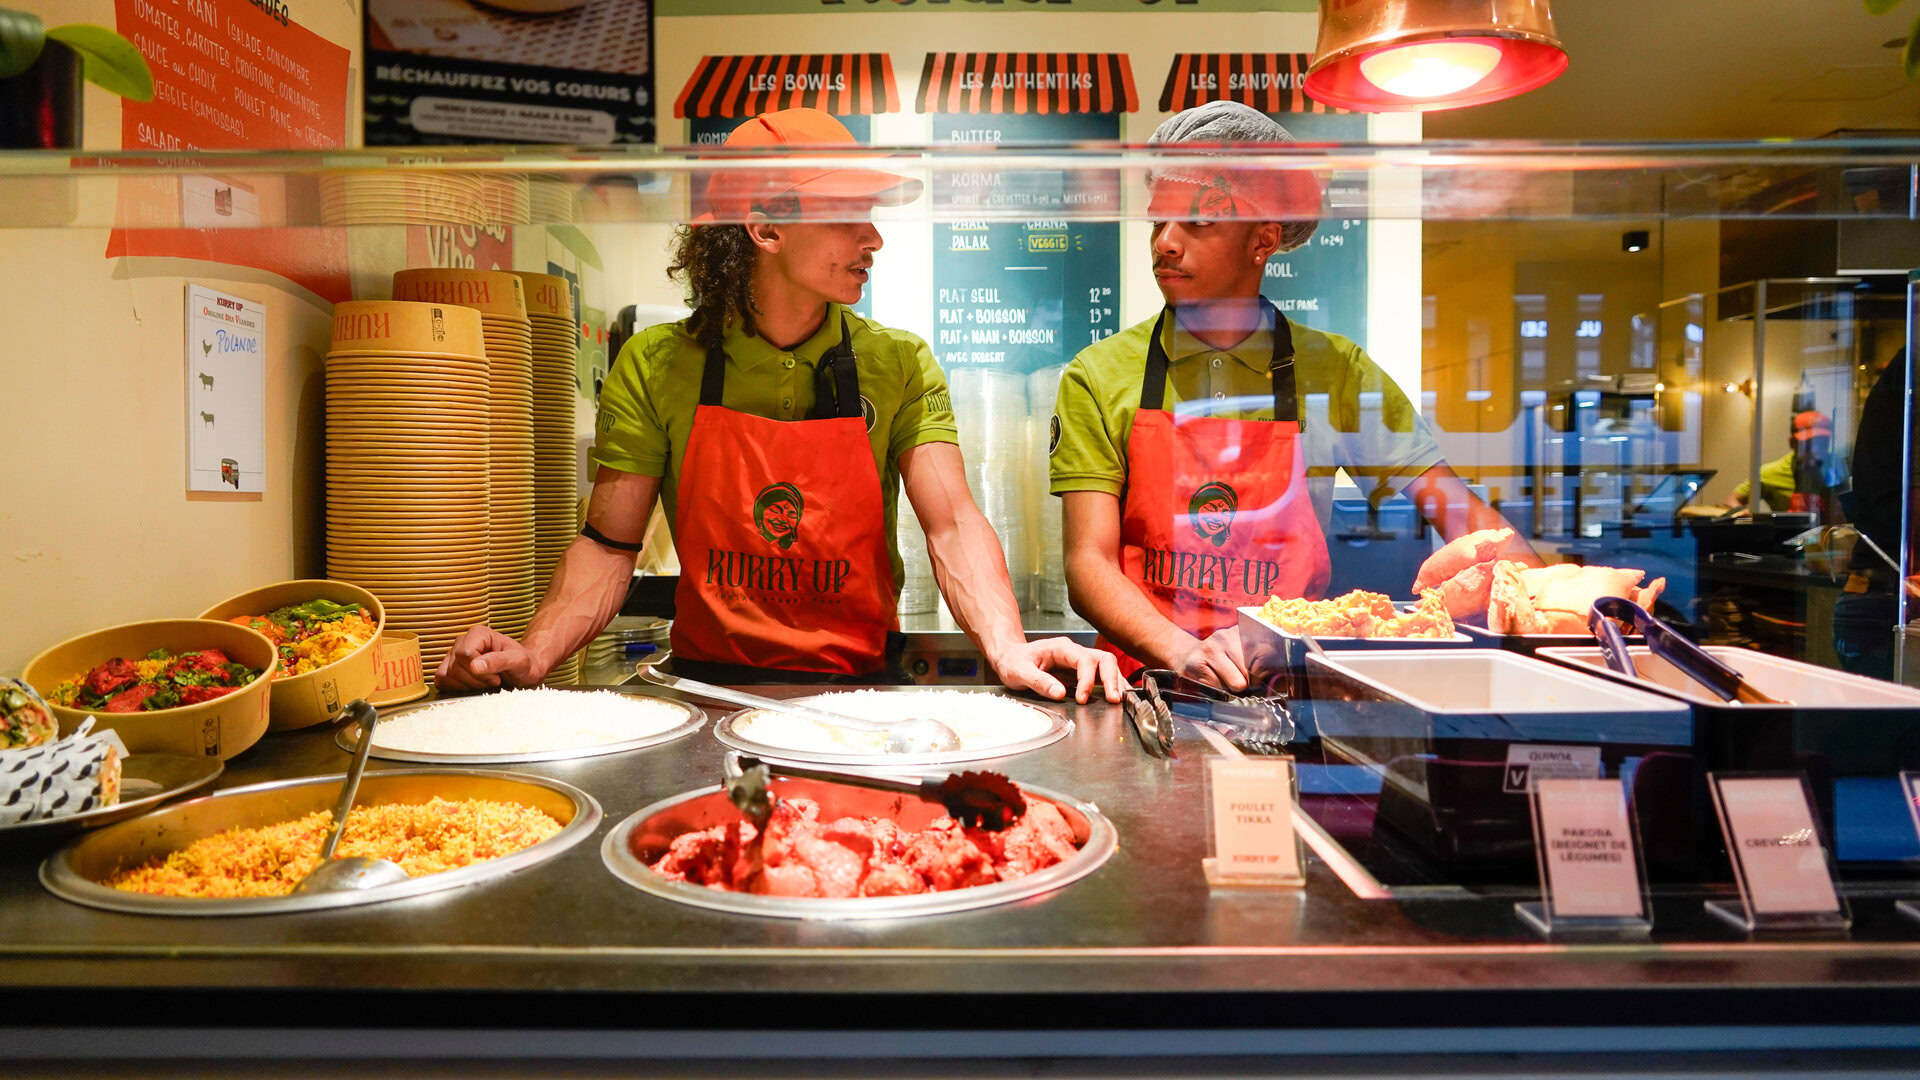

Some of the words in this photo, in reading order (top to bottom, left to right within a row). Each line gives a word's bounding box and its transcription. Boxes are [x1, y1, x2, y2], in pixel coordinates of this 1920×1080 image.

[134, 32, 169, 68] SAUCE
[234, 86, 266, 118] POULET
[749, 74, 777, 92] LES
[784, 73, 846, 92] BOWLS
[958, 72, 984, 90] LES
[990, 72, 1093, 90] AUTHENTIKS
[1190, 73, 1218, 90] LES
[376, 64, 505, 91] RÉCHAUFFEZ
[510, 78, 550, 94] VOS
[555, 82, 631, 102] COEURS
[138, 121, 181, 152] SALADE
[951, 130, 1002, 144] BUTTER
[951, 173, 1002, 187] KORMA
[951, 235, 990, 250] PALAK
[1031, 238, 1066, 249] VEGGIE
[939, 288, 966, 303] PLAT
[971, 288, 1001, 303] SEUL
[216, 297, 236, 310] KURRY
[236, 303, 244, 312] UP
[939, 308, 964, 324] PLAT
[976, 308, 1026, 324] BOISSON
[939, 329, 961, 344] PLAT
[971, 329, 1000, 344] NAAN
[1008, 329, 1054, 344] BOISSON
[945, 352, 968, 363] AVEC
[706, 549, 804, 592] KURRY
[813, 559, 850, 594] UP
[1144, 547, 1235, 592] KURRY
[1243, 557, 1280, 597] UP
[1529, 751, 1572, 761] QUINOA
[1230, 803, 1275, 812] POULET
[1236, 815, 1272, 824] TIKKA
[1561, 829, 1613, 838] PAKORA
[1611, 840, 1627, 850] DE
